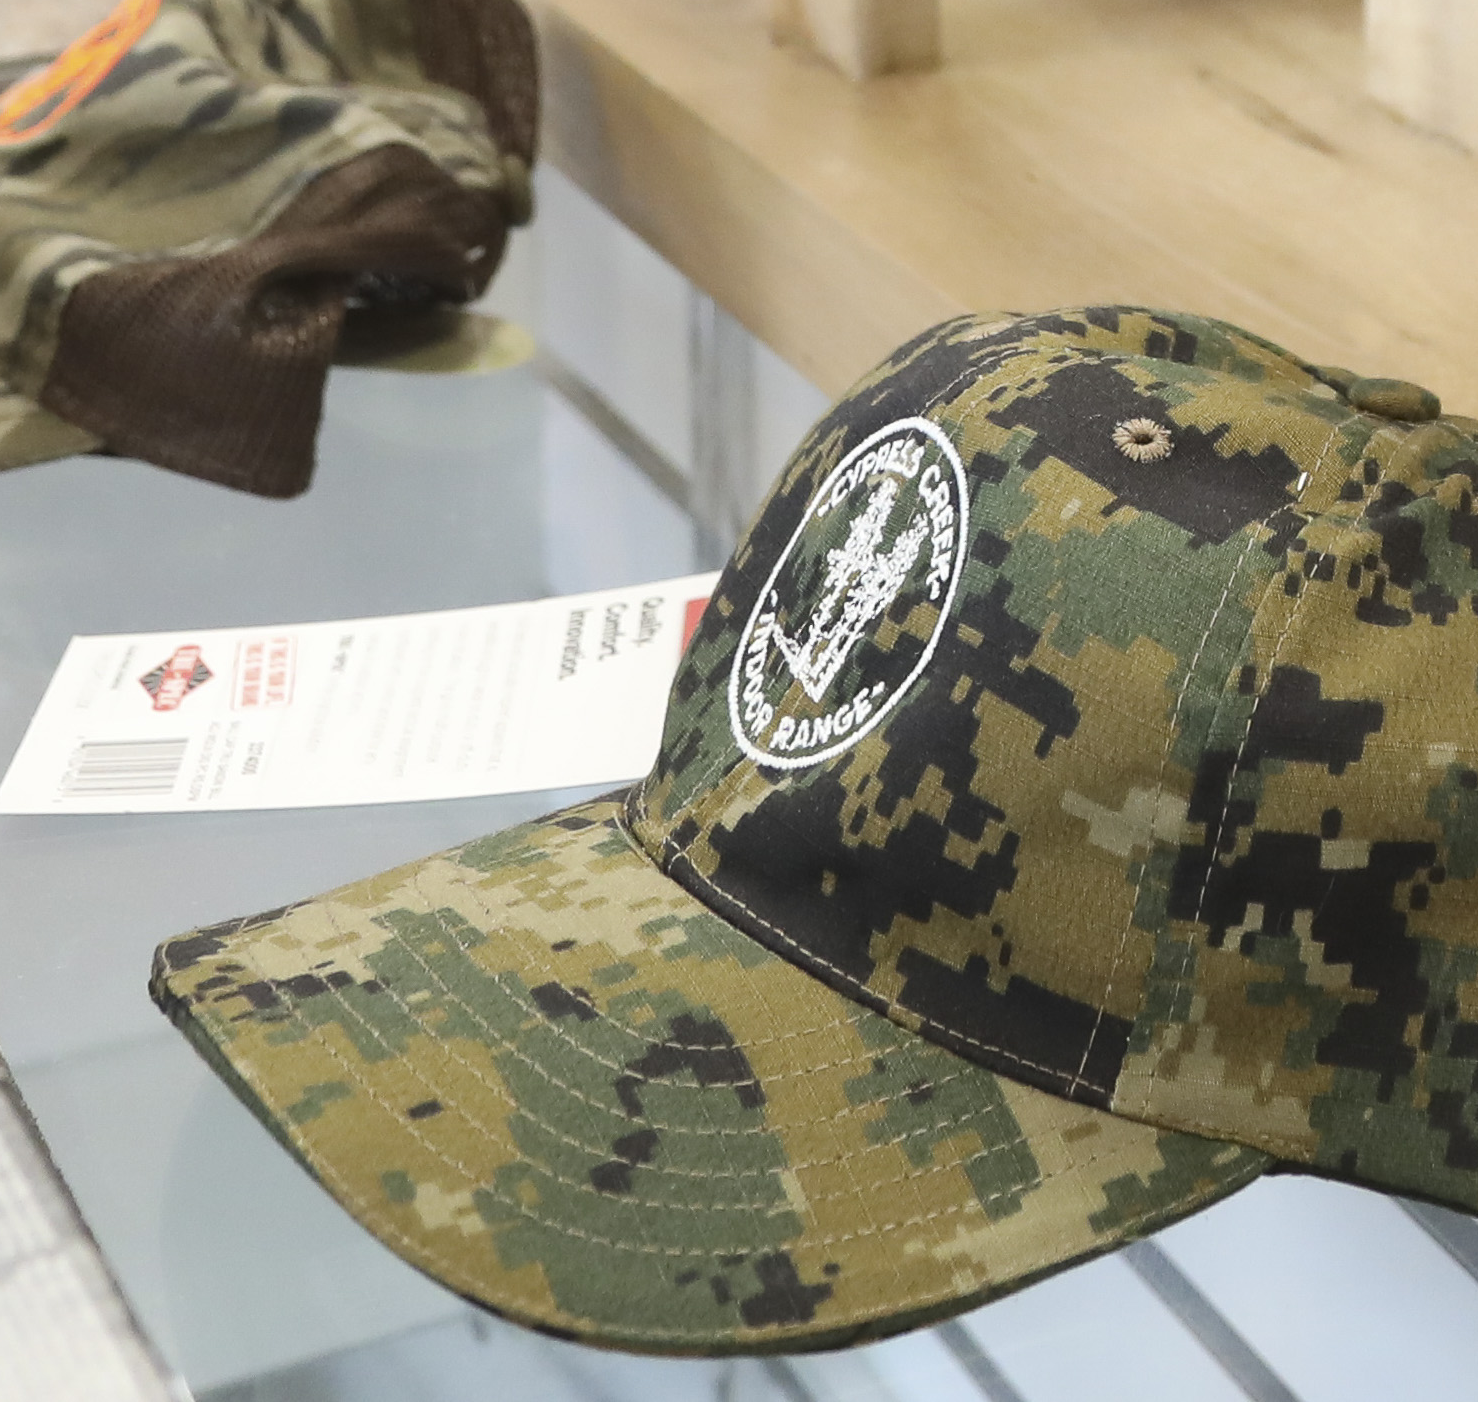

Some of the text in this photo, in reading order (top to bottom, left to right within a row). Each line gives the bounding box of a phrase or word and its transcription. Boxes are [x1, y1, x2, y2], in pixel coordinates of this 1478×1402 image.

[831, 438, 955, 582] CYPRESS CREEK
[742, 610, 873, 752] INDOOR RANGE
